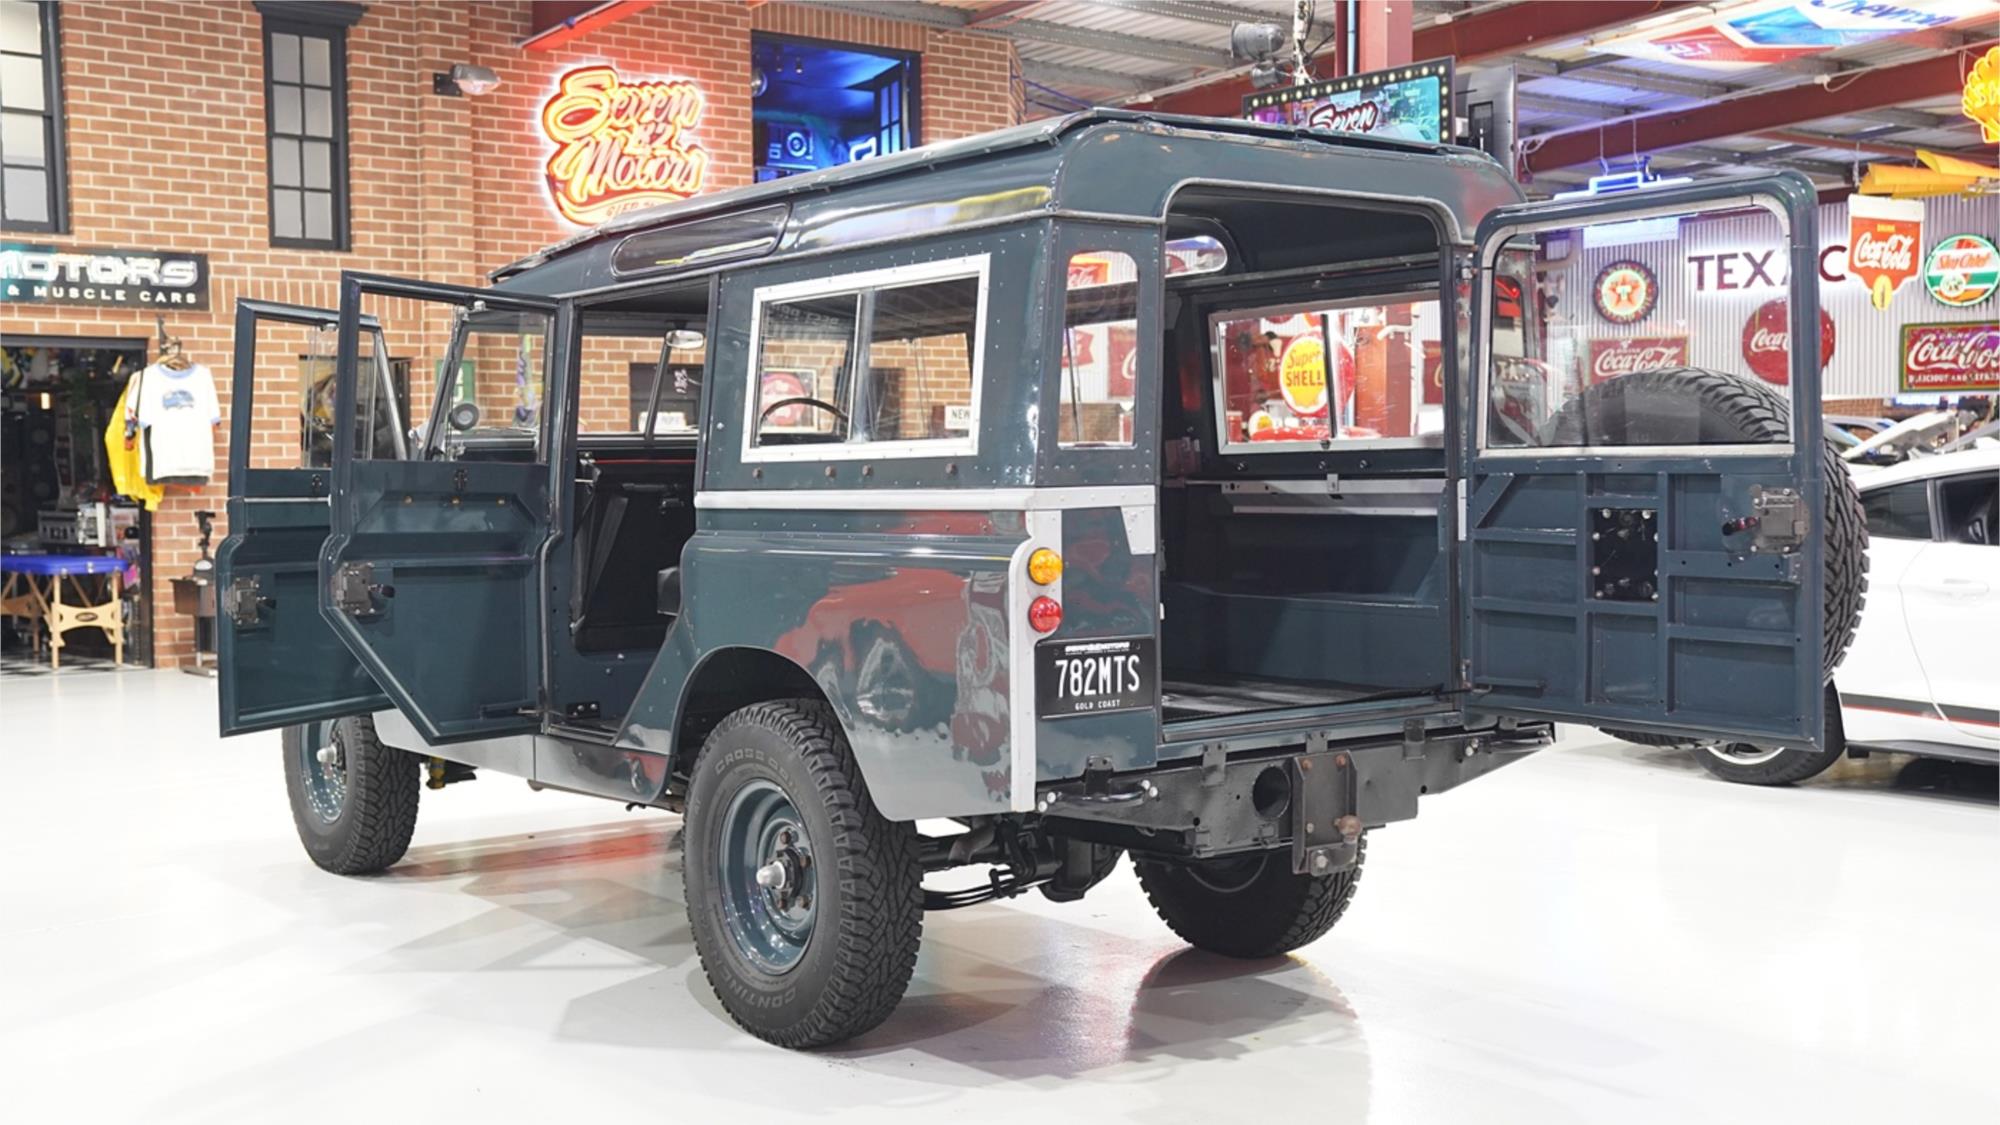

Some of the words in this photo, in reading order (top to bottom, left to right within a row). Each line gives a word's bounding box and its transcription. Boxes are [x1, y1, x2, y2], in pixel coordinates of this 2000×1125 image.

[543, 66, 703, 143] Seven
[1309, 101, 1379, 132] Seven
[548, 132, 708, 203] Motors
[7, 284, 20, 297] &
[33, 285, 127, 301] MUSCLE
[139, 290, 198, 305] CARS
[1286, 348, 1322, 369] Super
[1285, 370, 1325, 387] SHELL
[1055, 654, 1140, 699] 782MTS
[1075, 701, 1094, 711] GOLD
[1097, 699, 1121, 709] COAST
